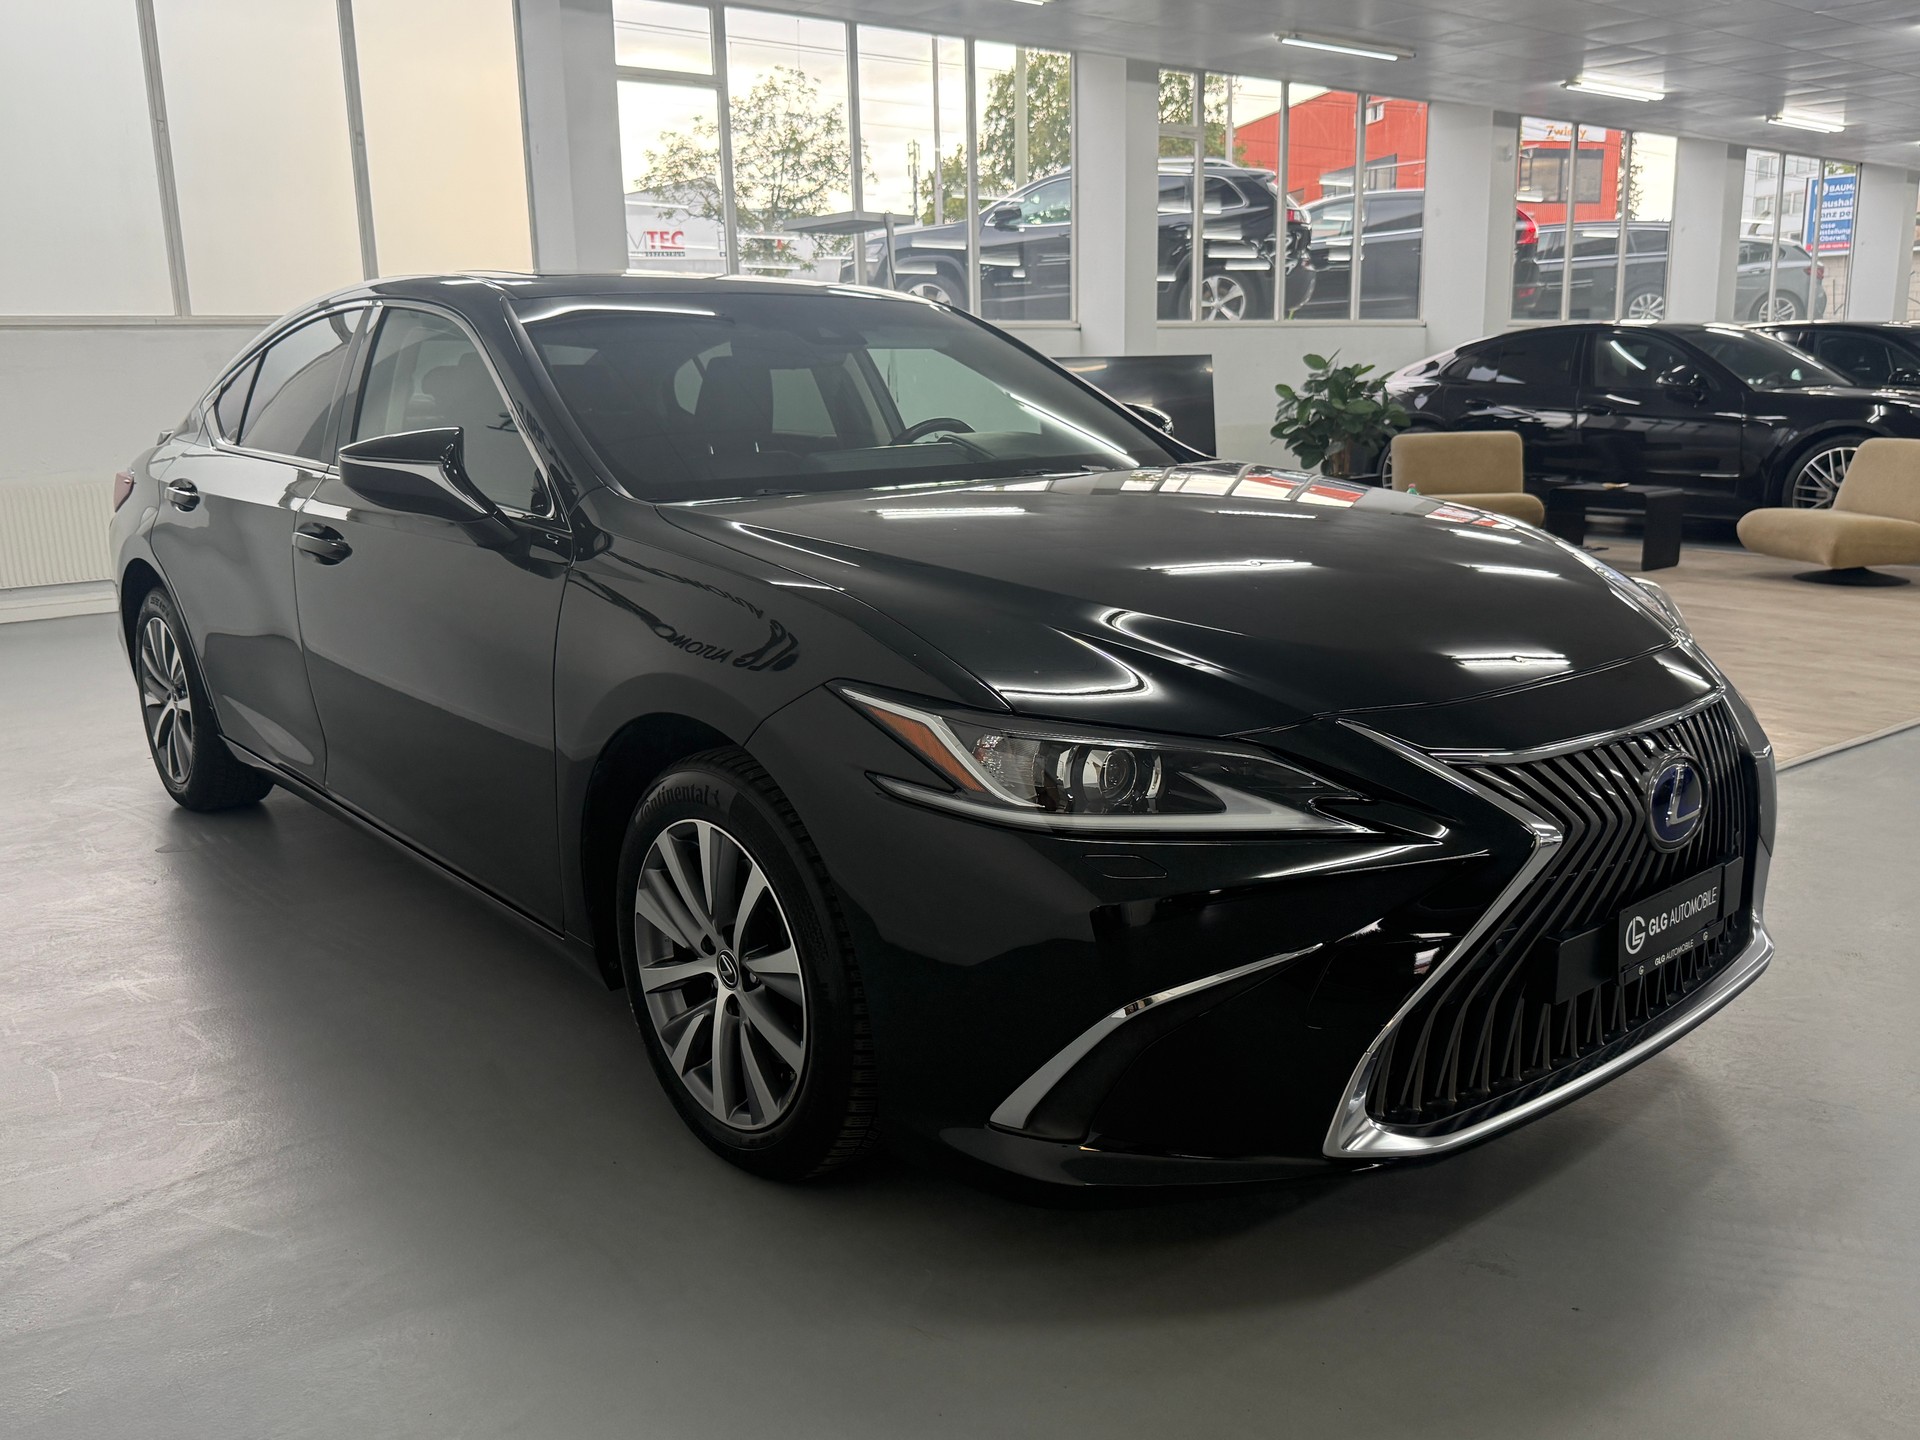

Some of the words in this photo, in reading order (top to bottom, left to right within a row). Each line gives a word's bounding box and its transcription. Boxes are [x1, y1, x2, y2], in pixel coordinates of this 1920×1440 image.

[1546, 126, 1587, 140] Zwicy
[1822, 198, 1853, 208] aushal
[1648, 912, 1668, 936] GLG
[1669, 886, 1718, 927] AUTOMOBILE
[1654, 954, 1666, 966] GLG
[1665, 938, 1694, 961] AUTOMOBILE
